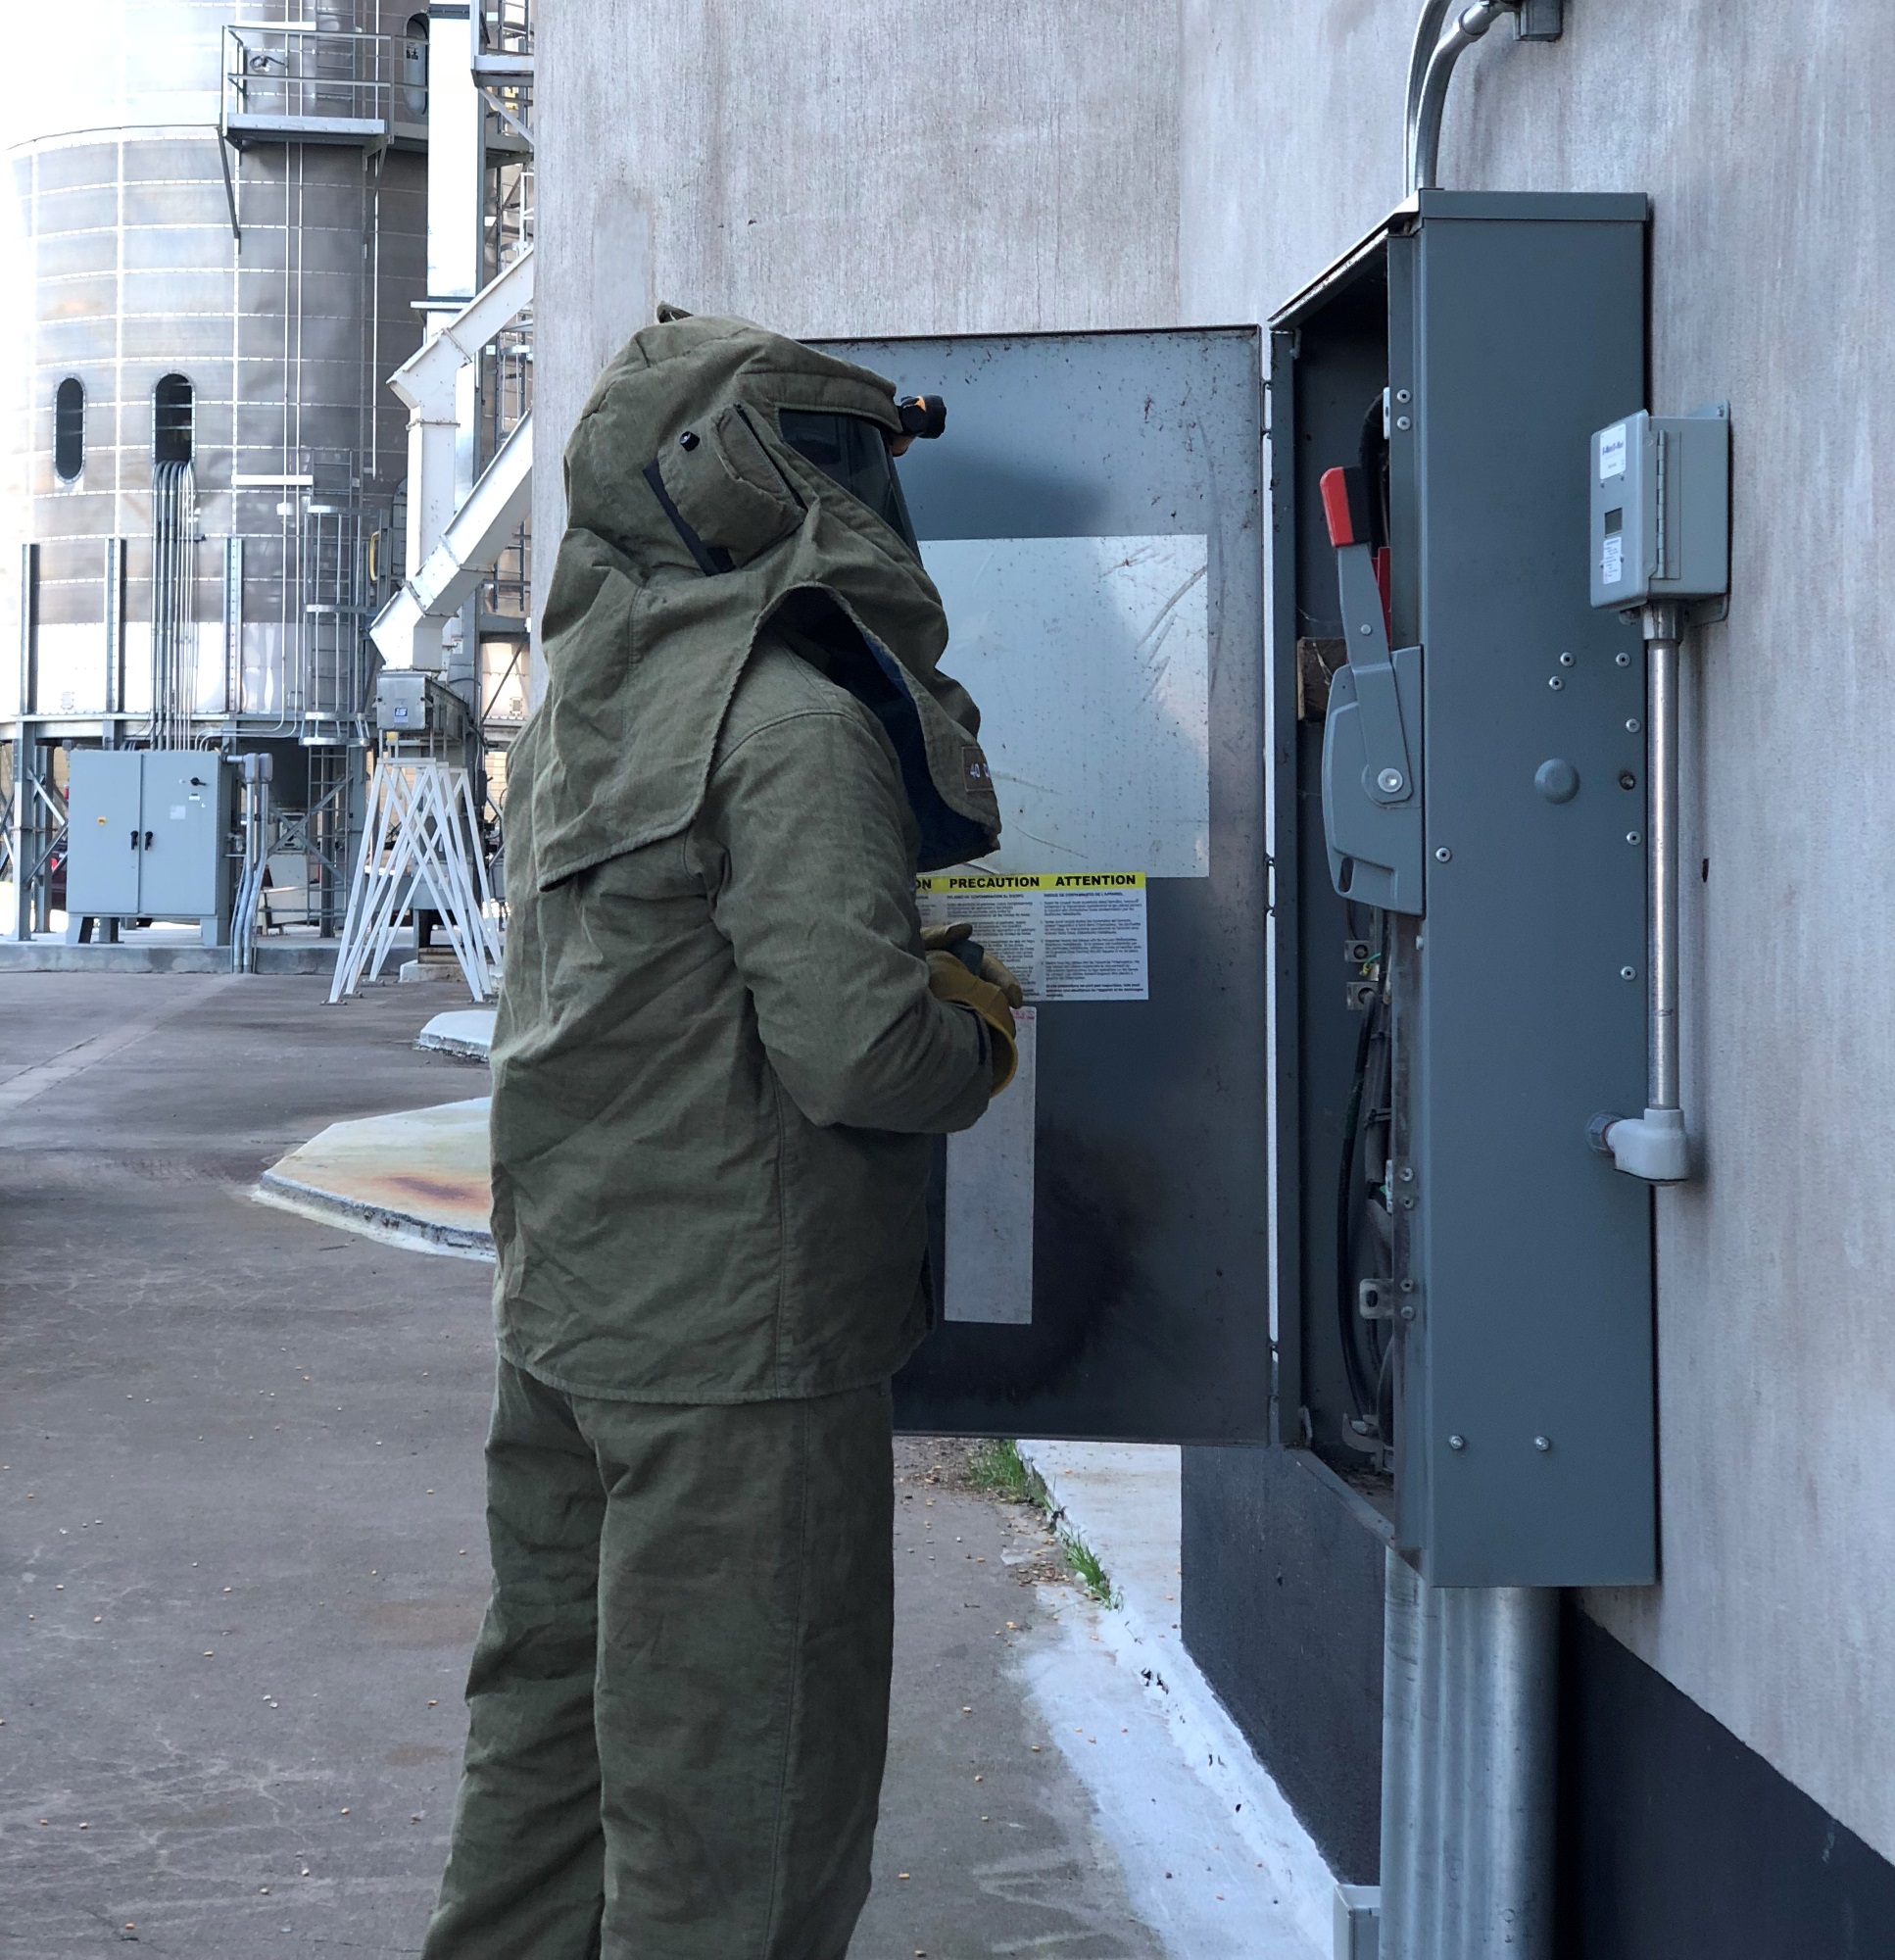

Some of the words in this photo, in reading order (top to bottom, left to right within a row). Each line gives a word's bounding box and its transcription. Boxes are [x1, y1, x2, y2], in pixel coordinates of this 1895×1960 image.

[970, 762, 981, 778] 40
[949, 877, 1041, 889] PRECAUTION
[1055, 874, 1137, 887] ATTENTION
